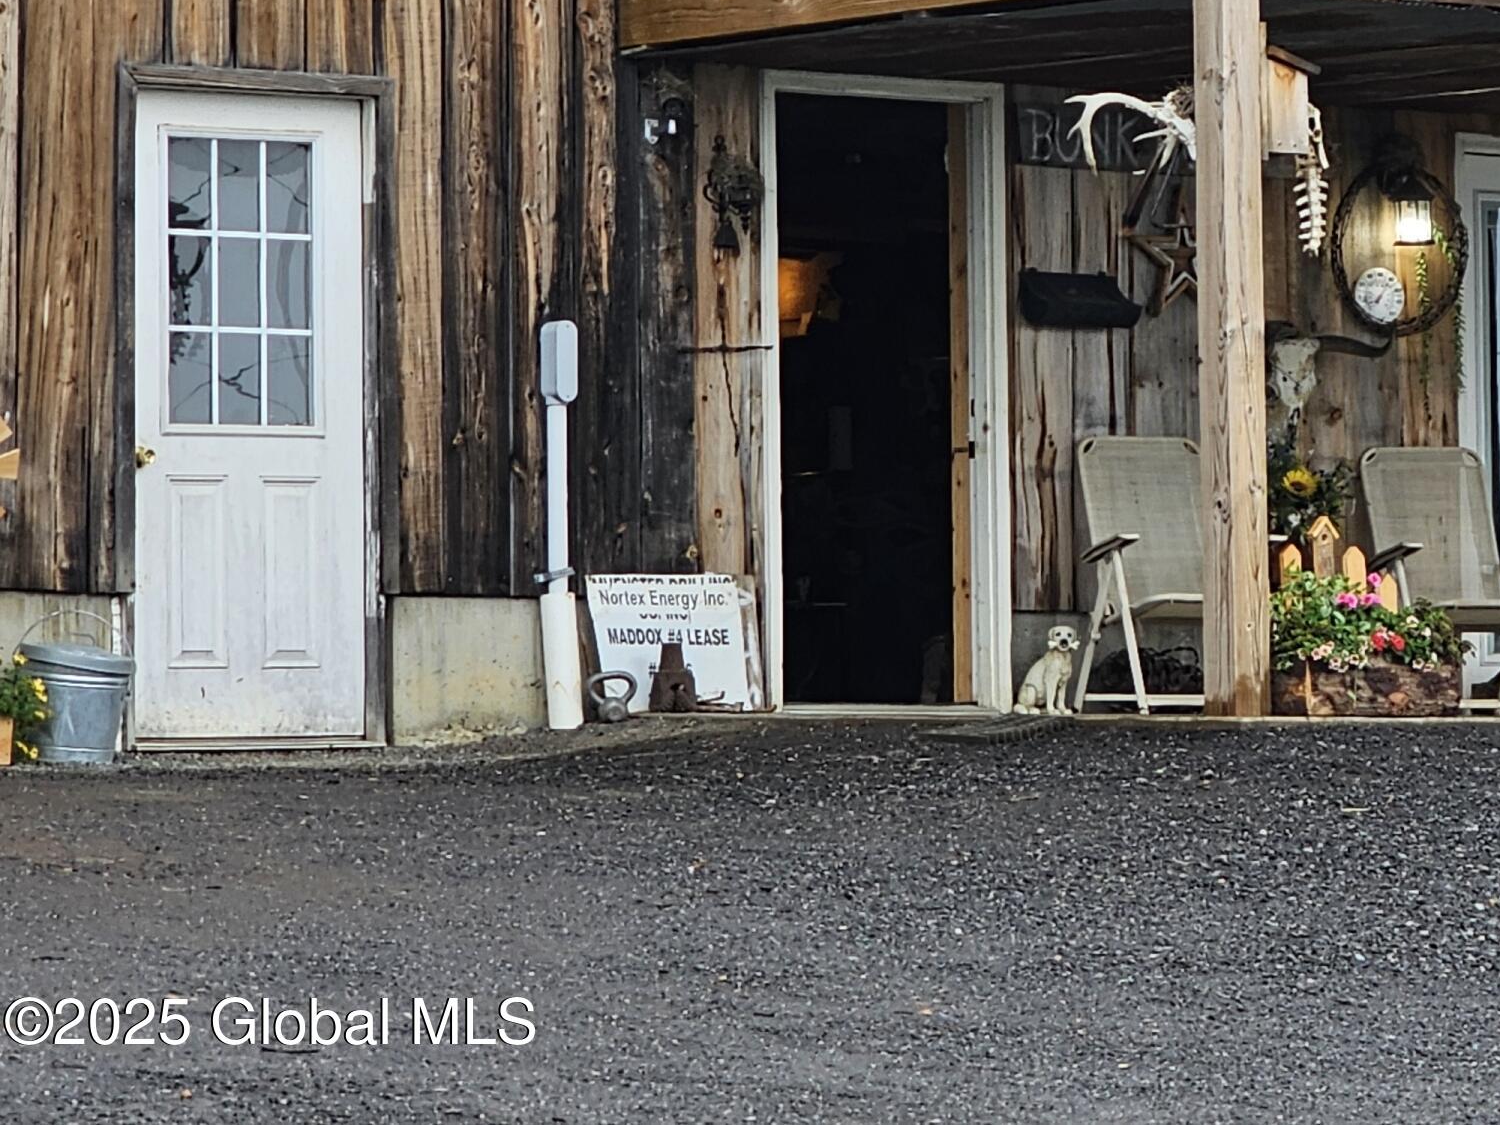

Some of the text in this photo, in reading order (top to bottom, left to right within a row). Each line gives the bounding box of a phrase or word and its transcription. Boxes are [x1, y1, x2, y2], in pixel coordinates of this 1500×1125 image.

[599, 590, 729, 610] Nortex Energy Inc.
[607, 628, 663, 645] MADDOX
[687, 629, 730, 646] LEASE
